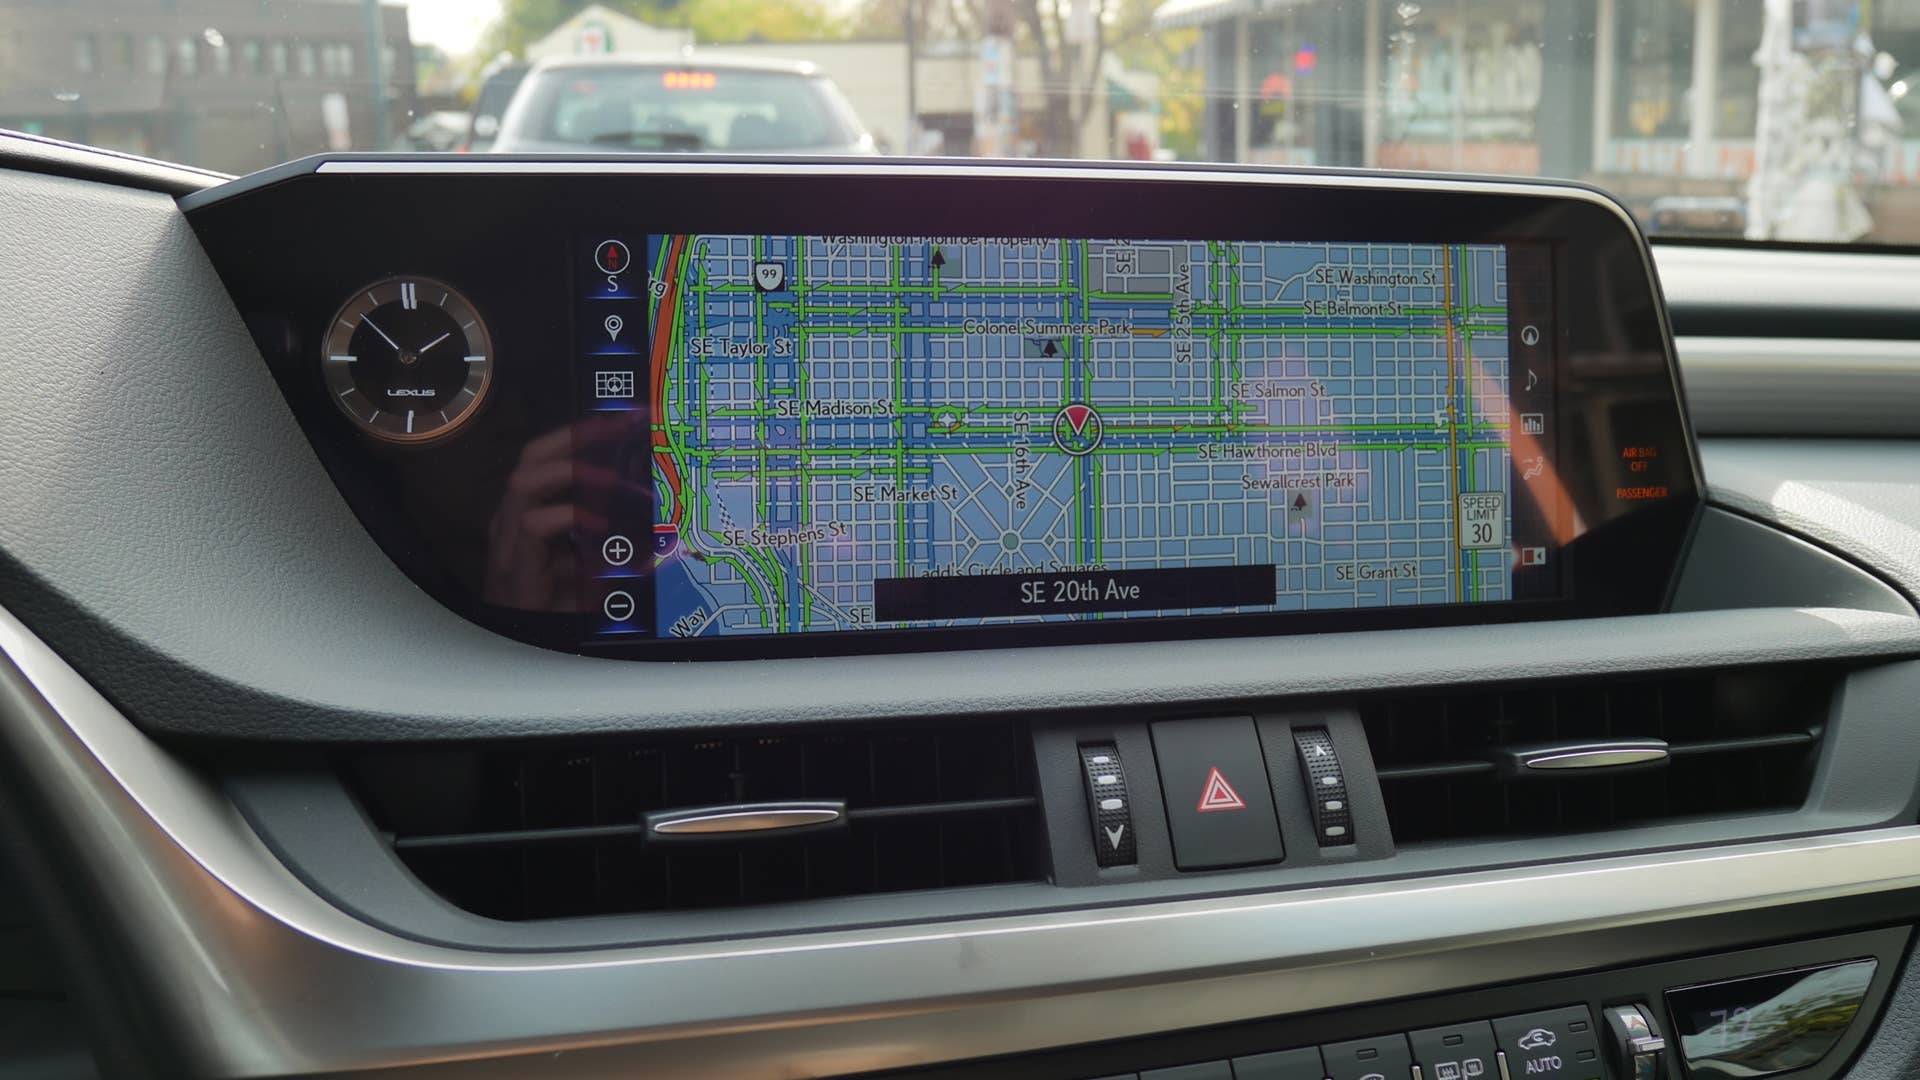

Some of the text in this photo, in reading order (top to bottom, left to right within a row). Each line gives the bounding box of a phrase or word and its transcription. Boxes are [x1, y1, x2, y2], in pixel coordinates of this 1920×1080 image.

[1116, 251, 1131, 273] SE
[761, 268, 778, 281] 99
[1316, 269, 1437, 287] SE Washington St
[608, 275, 618, 292] S
[1176, 264, 1191, 363] SE 25th Ave
[1304, 302, 1402, 316] SE Belmont St
[963, 319, 1130, 335] Colonel Summers Park
[691, 338, 791, 357] SE Taylor St
[387, 388, 436, 397] LEXUS
[1231, 383, 1325, 398] SE Salmon St
[778, 401, 894, 416] SE Madison St
[1199, 443, 1337, 459] SE Hawthorne Blvd
[1013, 412, 1030, 510] SE 16th Ave
[1242, 473, 1354, 490] Sewallcrest Park
[854, 485, 957, 502] SE Market St
[1616, 487, 1667, 499] PASSENGER
[1462, 496, 1501, 509] SPEED
[1466, 508, 1497, 520] LIMIT
[723, 521, 846, 547] SE Stephens St
[1472, 523, 1492, 543] 30
[659, 536, 667, 547] 5
[1336, 564, 1417, 580] SE Grant St
[1021, 578, 1140, 604] SE 20th Ave
[671, 607, 707, 637] Way
[850, 607, 870, 623] SE
[1525, 1055, 1562, 1074] AUTO
